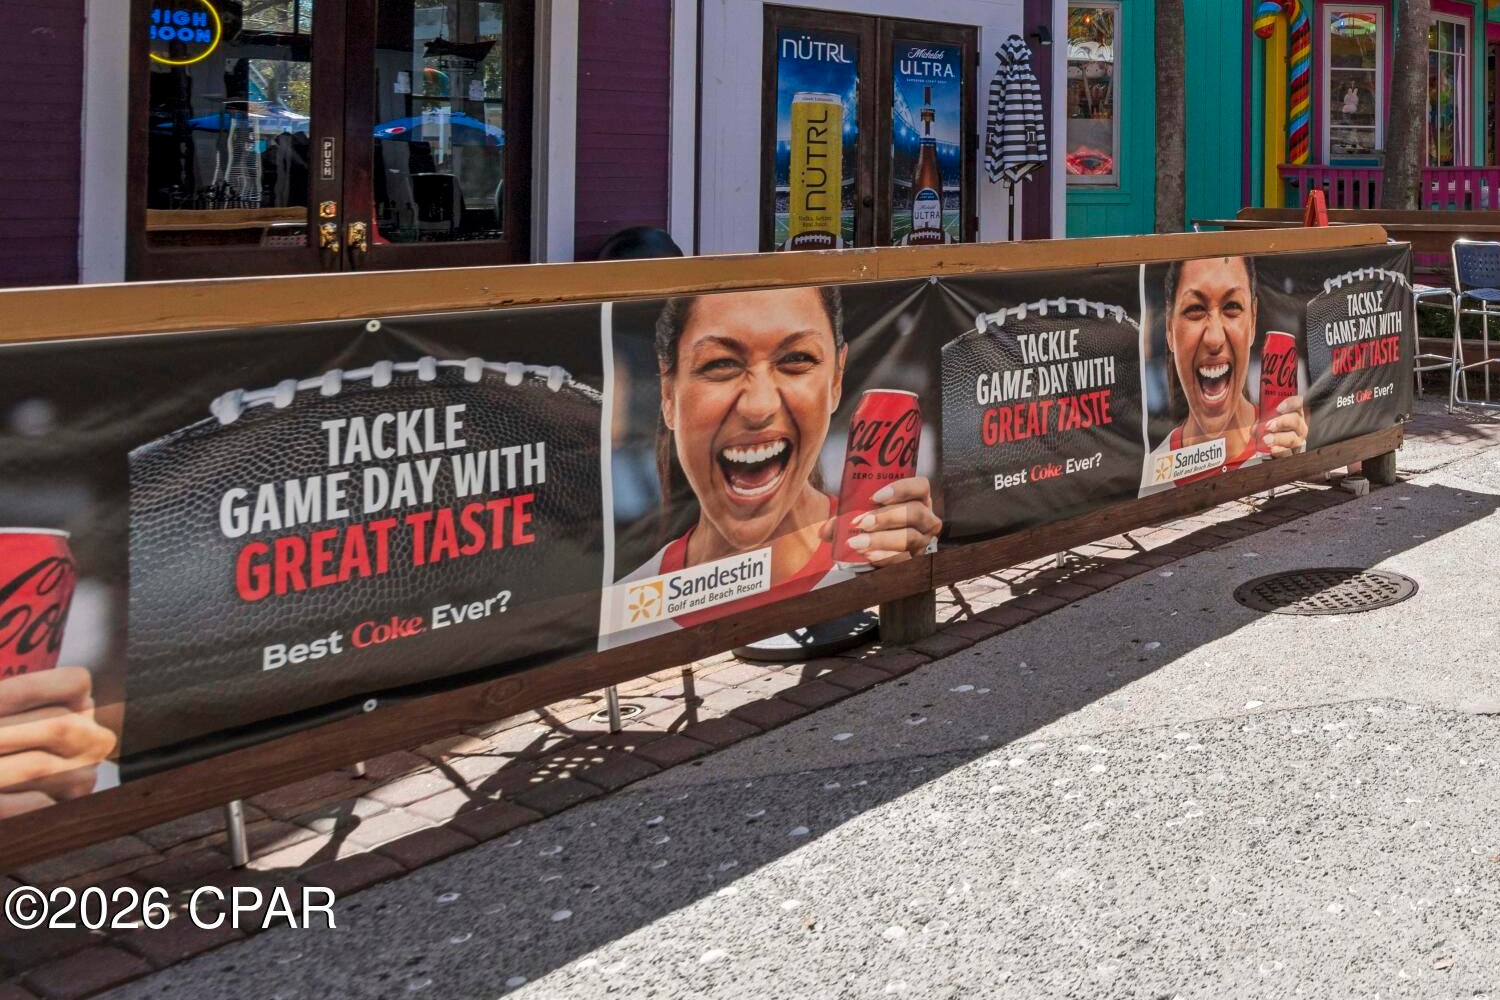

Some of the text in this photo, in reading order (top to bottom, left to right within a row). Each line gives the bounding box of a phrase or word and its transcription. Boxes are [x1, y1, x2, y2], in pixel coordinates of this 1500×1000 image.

[900, 59, 956, 78] ULTRA
[324, 141, 332, 176] PUSH
[1347, 290, 1384, 317] TACKLE
[1017, 328, 1080, 365] TACKLE
[1325, 310, 1402, 346] GAME DAY WITH
[1332, 335, 1399, 377] GREAT TASTE
[976, 355, 1116, 405] GAME DAY WITH
[1336, 393, 1355, 408] Best
[1374, 383, 1394, 399] Ever?
[321, 404, 467, 467] TACKLE
[982, 389, 1113, 446] GREAT TASTE
[994, 452, 1103, 491] Best Coke Ever?
[1174, 444, 1223, 469] Sandestin
[219, 441, 546, 539] GAME DAY WITH
[852, 472, 873, 480] ZERO
[235, 493, 536, 602] GREAT TASTE
[667, 580, 763, 614] Golf and Beach Resort
[669, 558, 764, 600] Sandestin
[262, 589, 512, 672] Best Coke Ever?
